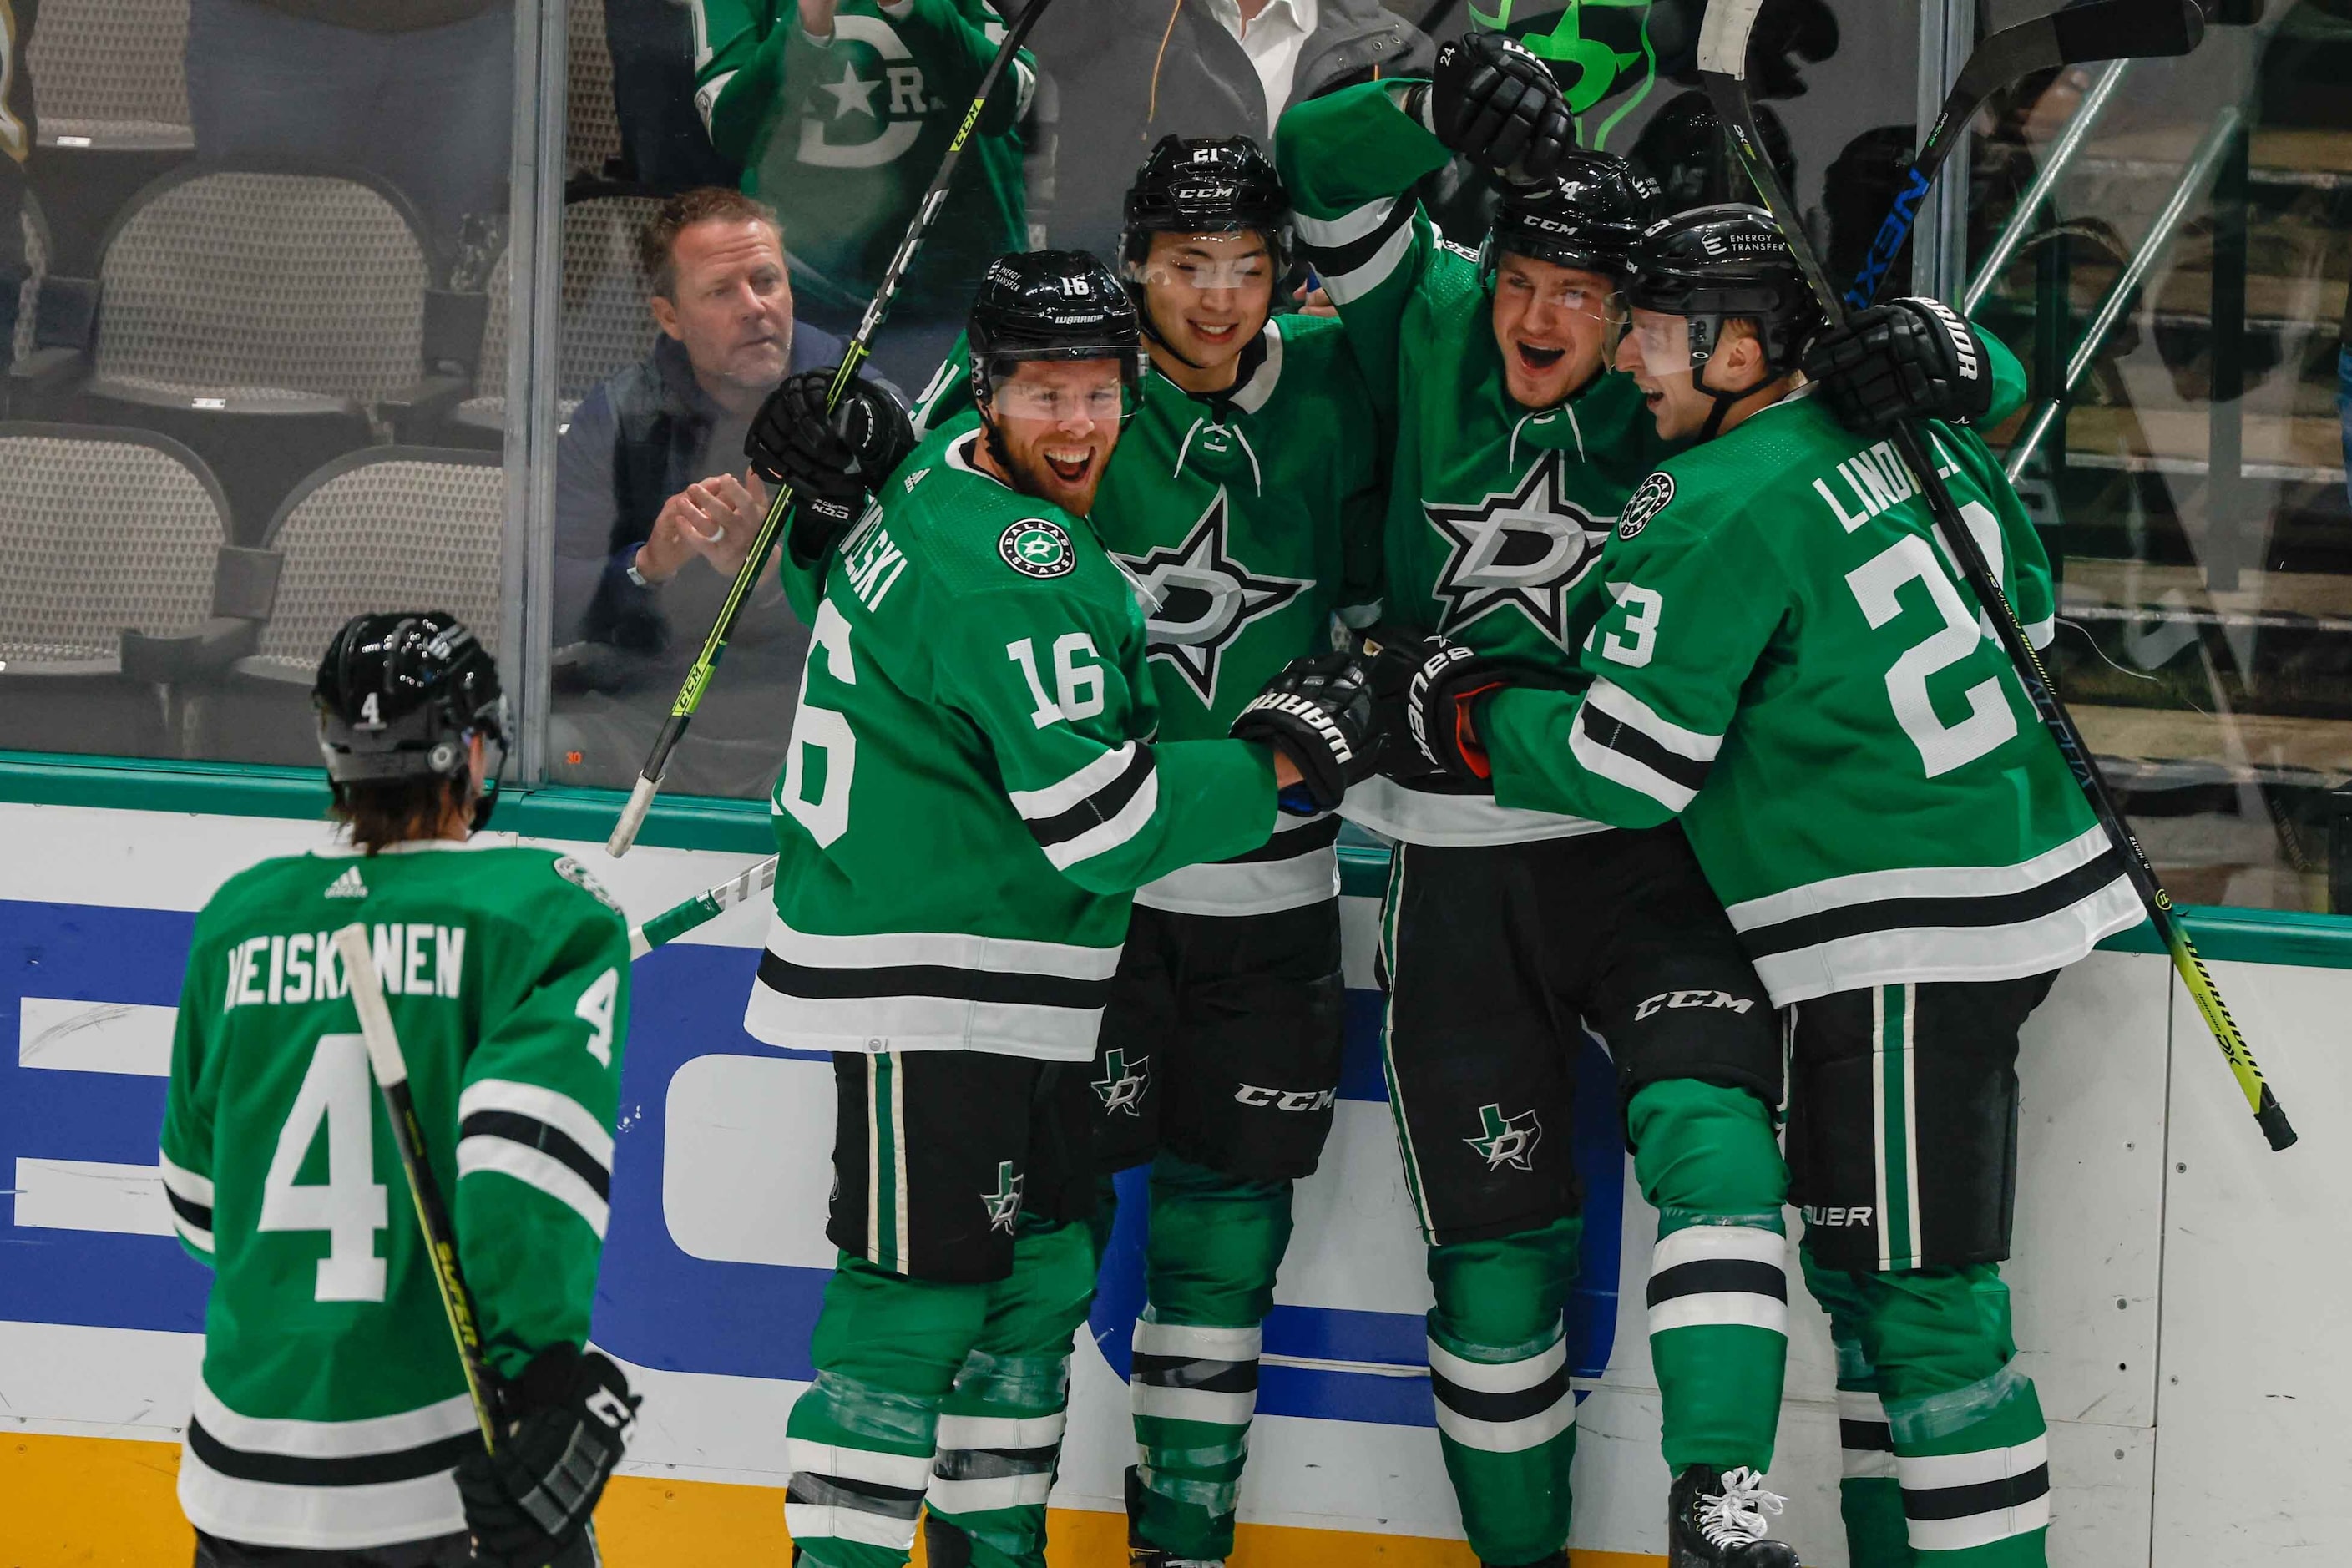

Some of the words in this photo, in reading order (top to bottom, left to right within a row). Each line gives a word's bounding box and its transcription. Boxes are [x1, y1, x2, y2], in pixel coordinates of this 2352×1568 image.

[1440, 48, 1455, 67] 24
[954, 103, 979, 148] CCM
[1193, 148, 1221, 164] 21
[1179, 188, 1234, 199] CCM
[1523, 215, 1578, 236] CCM
[1729, 234, 1773, 243] ENERGY
[1731, 243, 1784, 252] TRANSFER
[994, 273, 1021, 292] TRANSFER
[999, 266, 1023, 281] ENERGY
[1060, 275, 1090, 296] 16
[1055, 313, 1105, 325] WARRIOR
[812, 503, 850, 521] CCM
[1004, 522, 1070, 547] DALLAS
[1011, 556, 1070, 574] STARS
[1996, 589, 2021, 630] ALPHA
[679, 666, 701, 709] CCM
[1006, 632, 1104, 730] 16
[354, 692, 387, 729] 4
[566, 751, 582, 766] 30
[2129, 836, 2145, 859] HINTZ
[1634, 990, 1755, 1023] CCM
[2184, 941, 2265, 1078] WARRIOR
[575, 967, 619, 1070] 4
[1233, 1083, 1337, 1112] CCM
[257, 1033, 388, 1302] 4
